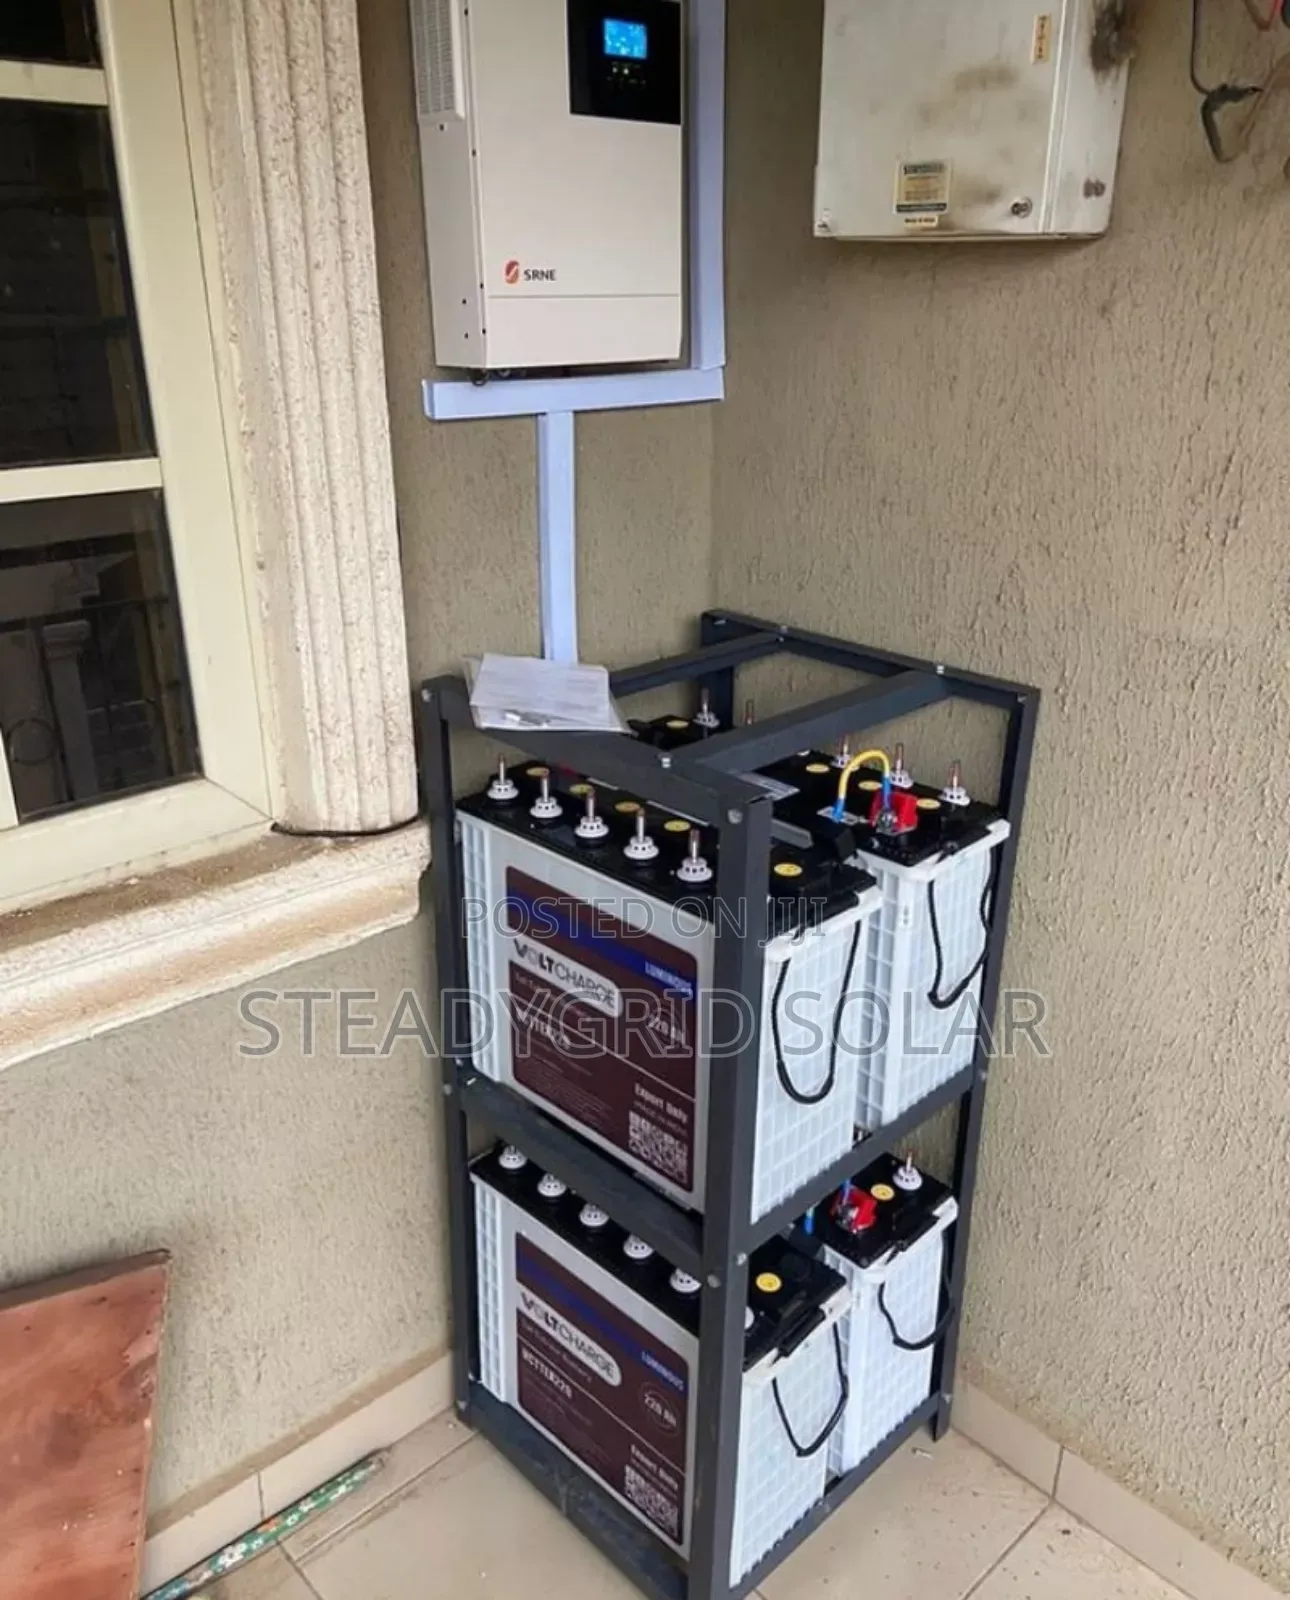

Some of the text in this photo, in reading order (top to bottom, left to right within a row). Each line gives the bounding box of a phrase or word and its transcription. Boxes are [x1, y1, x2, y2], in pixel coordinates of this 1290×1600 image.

[523, 268, 557, 281] SRNE
[513, 937, 617, 1009] VOLTCHARGE
[520, 1290, 616, 1379] VOLTCHARGE
